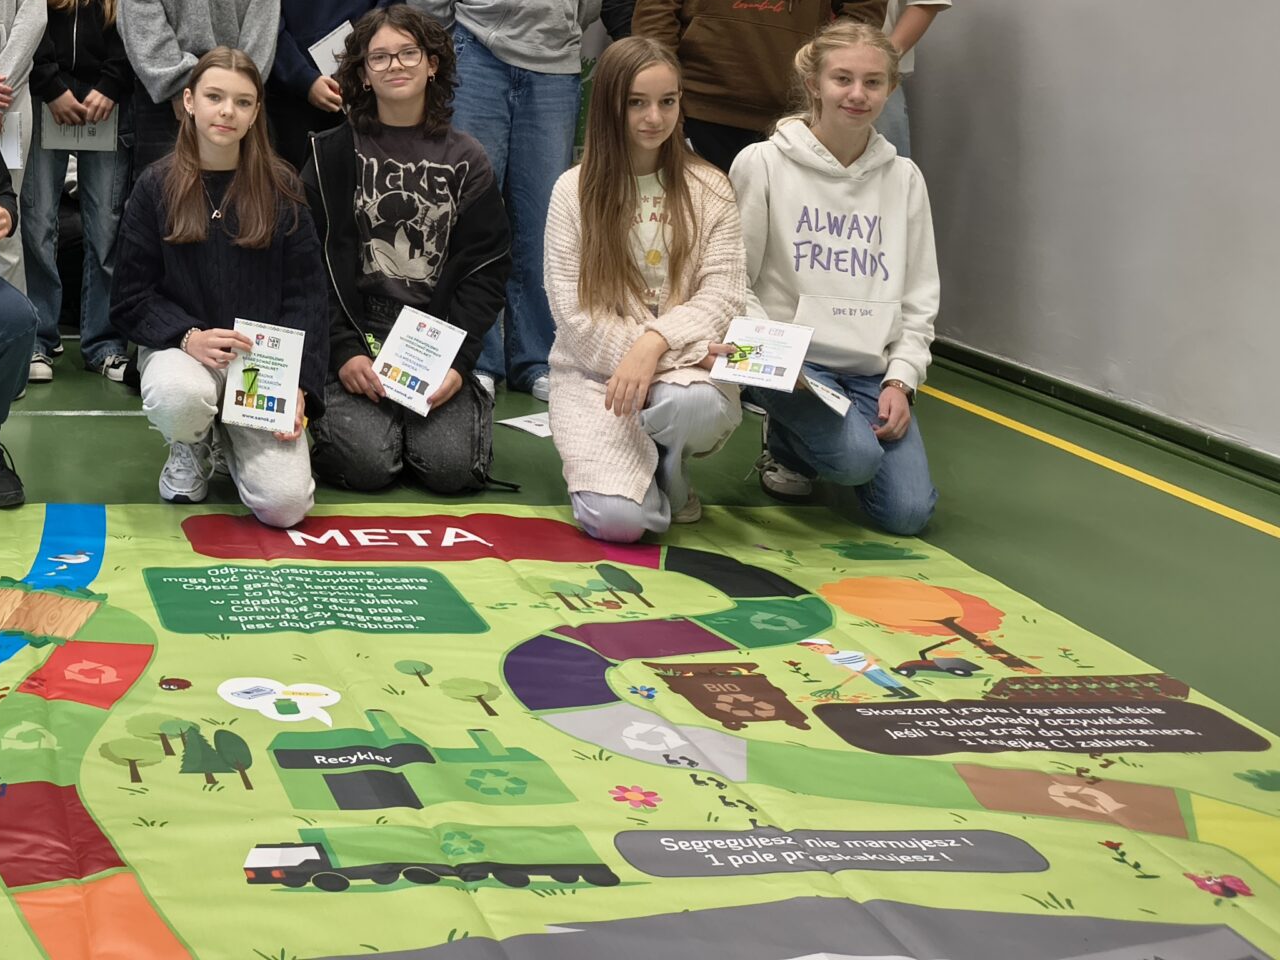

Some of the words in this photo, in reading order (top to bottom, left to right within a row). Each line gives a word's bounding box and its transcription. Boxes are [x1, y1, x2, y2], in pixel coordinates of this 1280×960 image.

[356, 151, 469, 208] ICKEY
[793, 240, 889, 281] FRIENDS
[286, 527, 494, 547] META
[703, 682, 738, 693] BIO
[856, 707, 950, 716] Skoszona
[940, 715, 1040, 728] bioodpady
[929, 729, 955, 737] to
[958, 729, 989, 737] nie
[1037, 728, 1064, 737] do
[1076, 738, 1155, 748] zabiera.
[313, 752, 394, 766] Recykler
[660, 835, 798, 853] Segregujesz
[804, 837, 840, 848] nie
[842, 837, 962, 851] marnujesz
[705, 854, 725, 866] 1
[727, 850, 778, 868] pole
